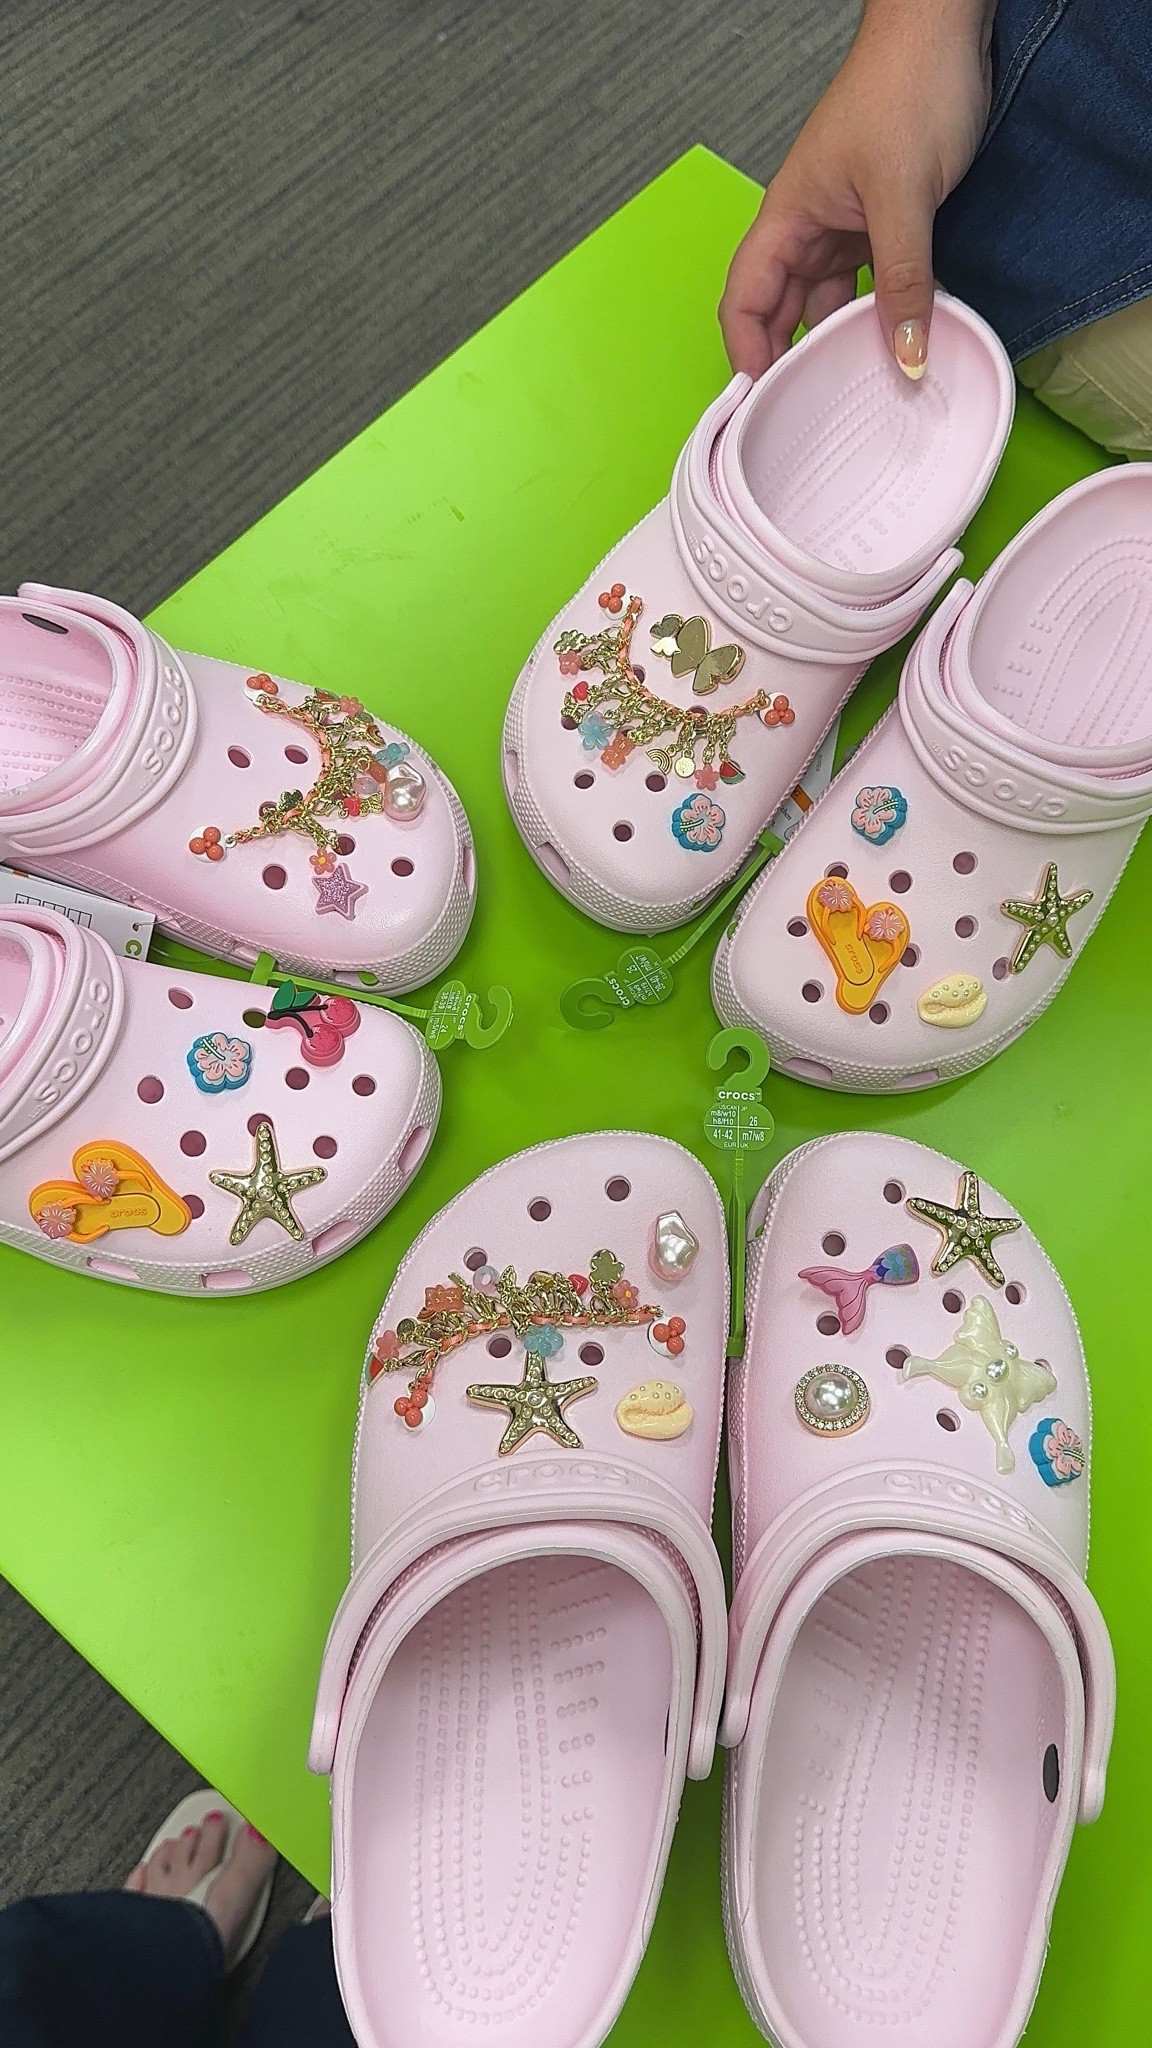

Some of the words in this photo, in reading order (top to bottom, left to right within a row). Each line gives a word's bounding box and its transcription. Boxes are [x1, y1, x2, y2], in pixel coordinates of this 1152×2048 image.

[695, 535, 793, 633] crocs
[141, 665, 182, 776] crocs
[943, 746, 1068, 817] crocs
[626, 964, 638, 974] 25
[845, 943, 864, 975] crocs
[607, 977, 630, 1006] crocs
[457, 994, 473, 1032] crocs
[35, 978, 110, 1105] crocs
[440, 1024, 449, 1033] 24
[718, 1091, 757, 1101] crocs
[713, 1129, 733, 1140] 41-42
[749, 1116, 758, 1126] 26
[742, 1131, 765, 1142] m7/w8
[109, 1208, 148, 1218] crocs
[473, 1463, 629, 1492] crocs
[884, 1472, 1032, 1531] crocs
